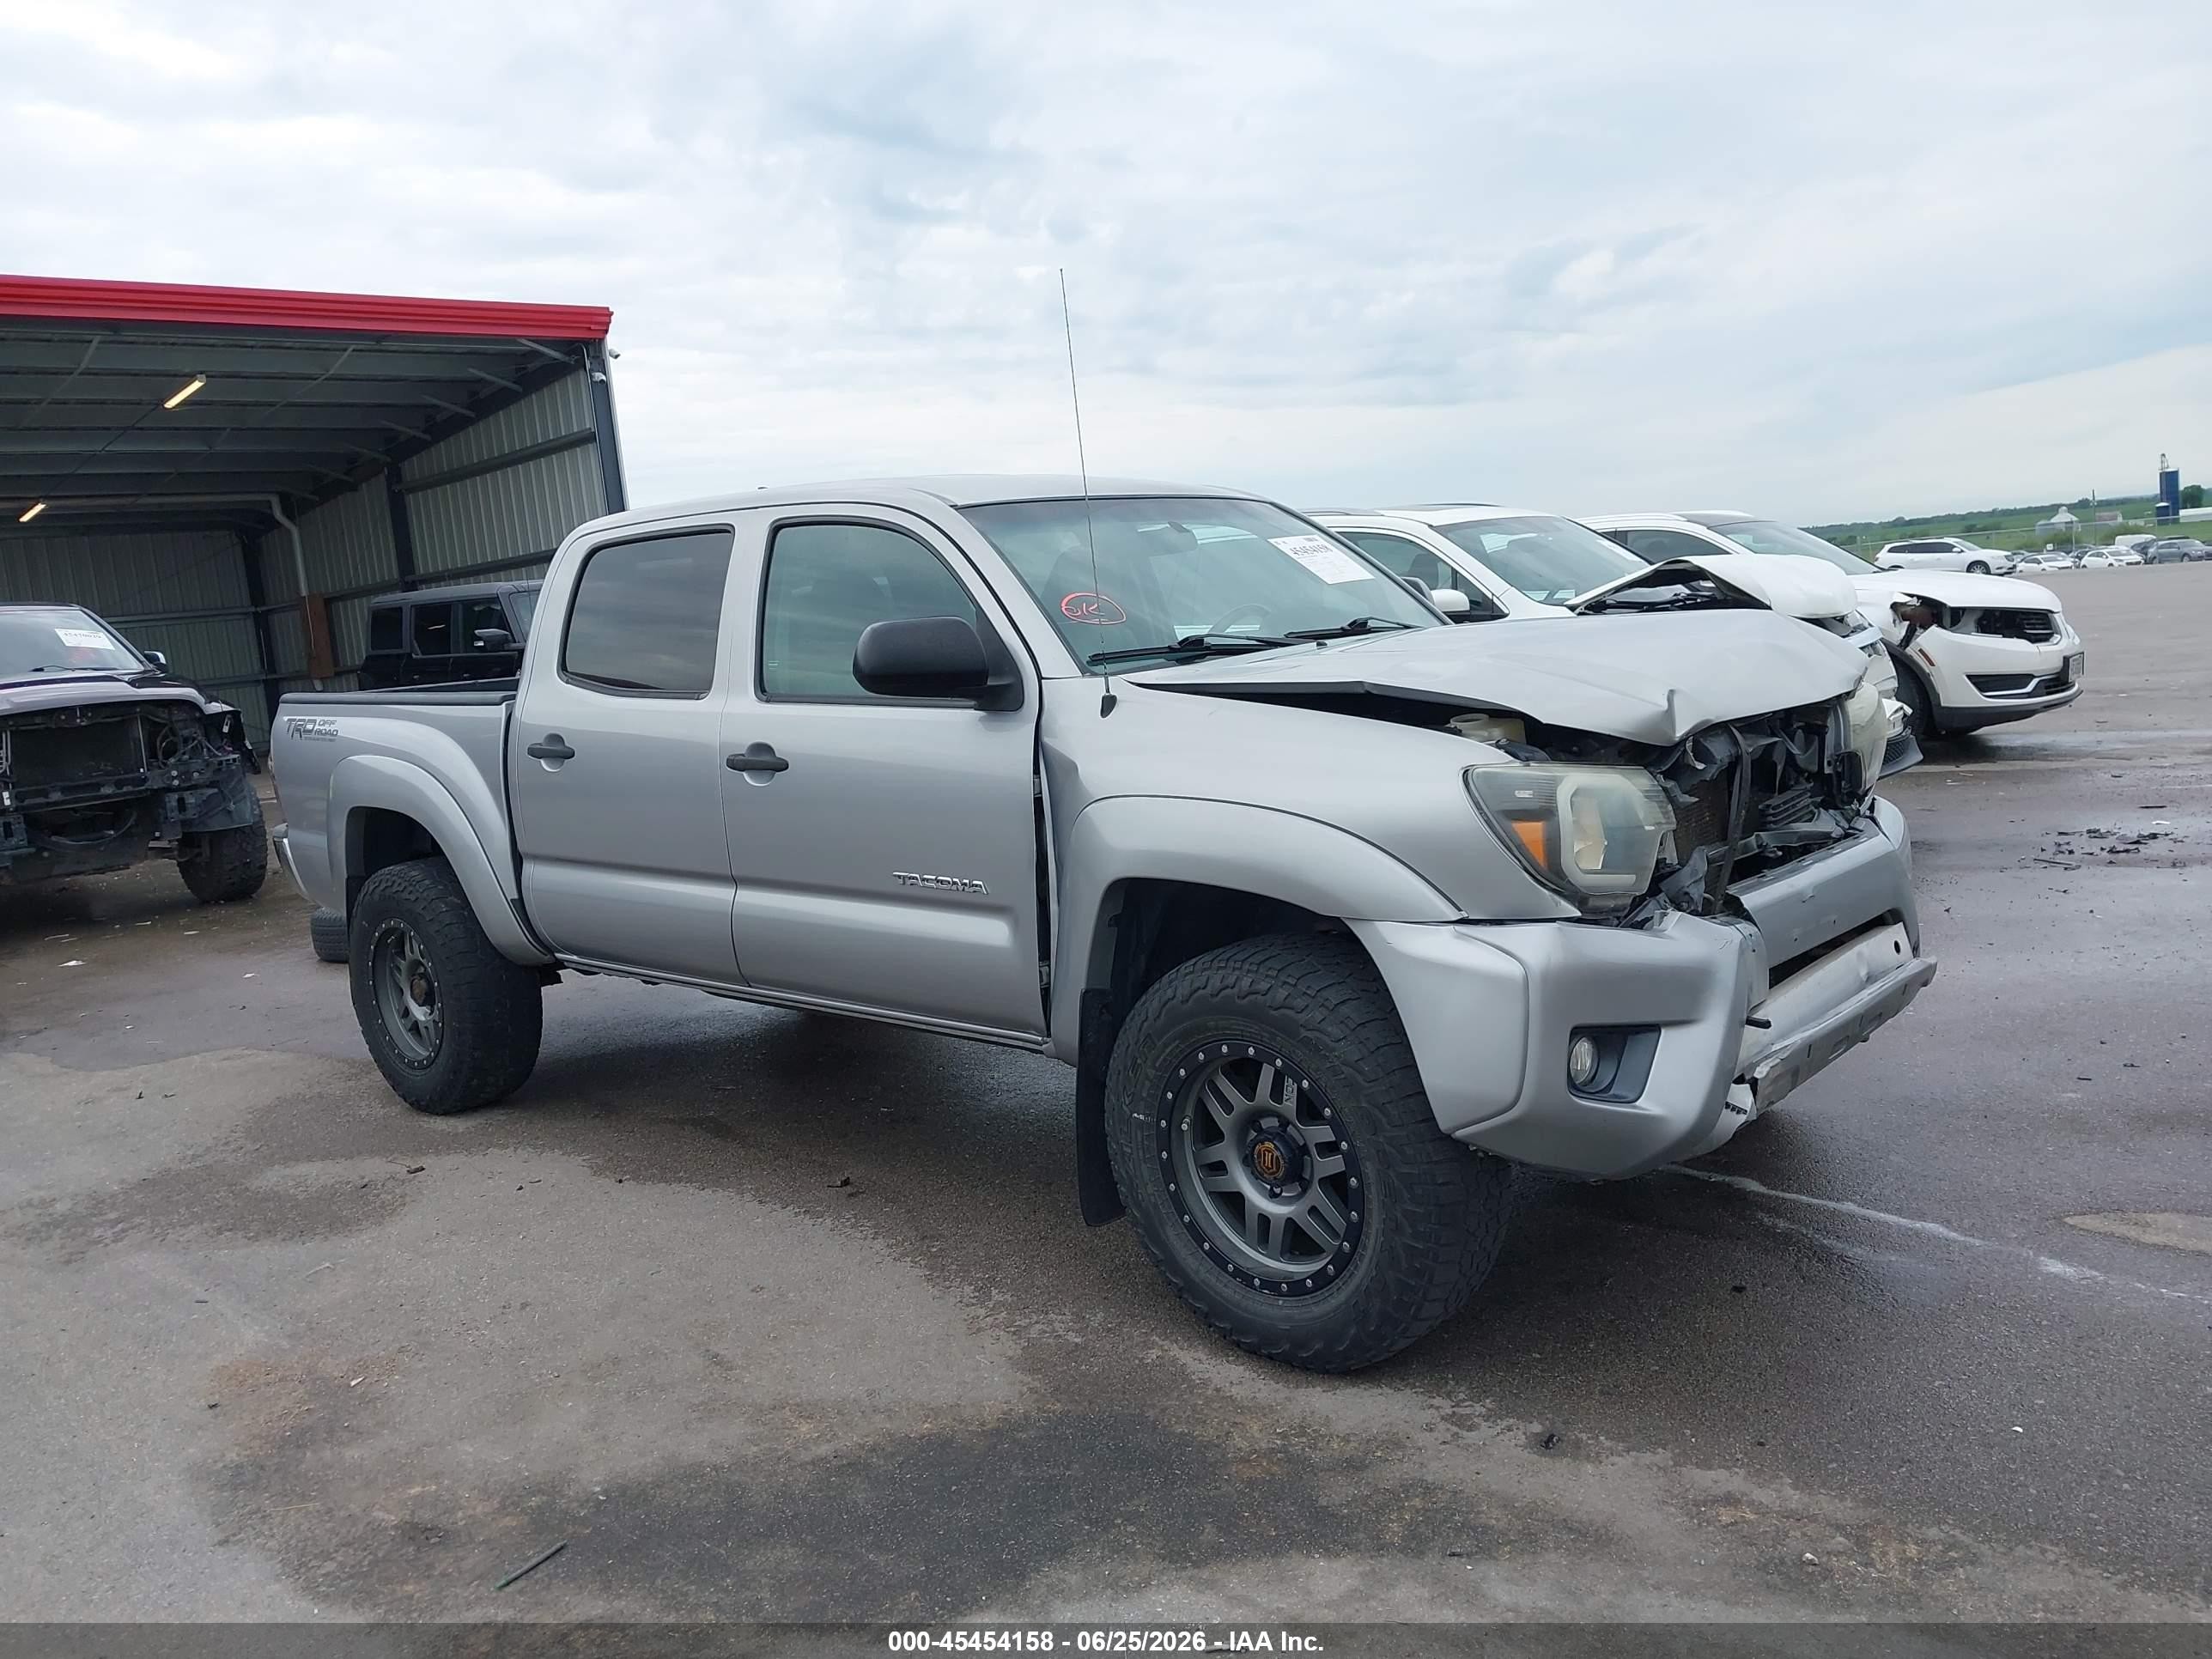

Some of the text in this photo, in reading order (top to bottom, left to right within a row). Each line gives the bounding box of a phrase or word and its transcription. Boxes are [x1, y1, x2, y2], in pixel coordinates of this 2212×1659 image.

[286, 718, 337, 740] TRD OFF
[314, 728, 339, 737] ROAD
[892, 872, 989, 895] TACOMA
